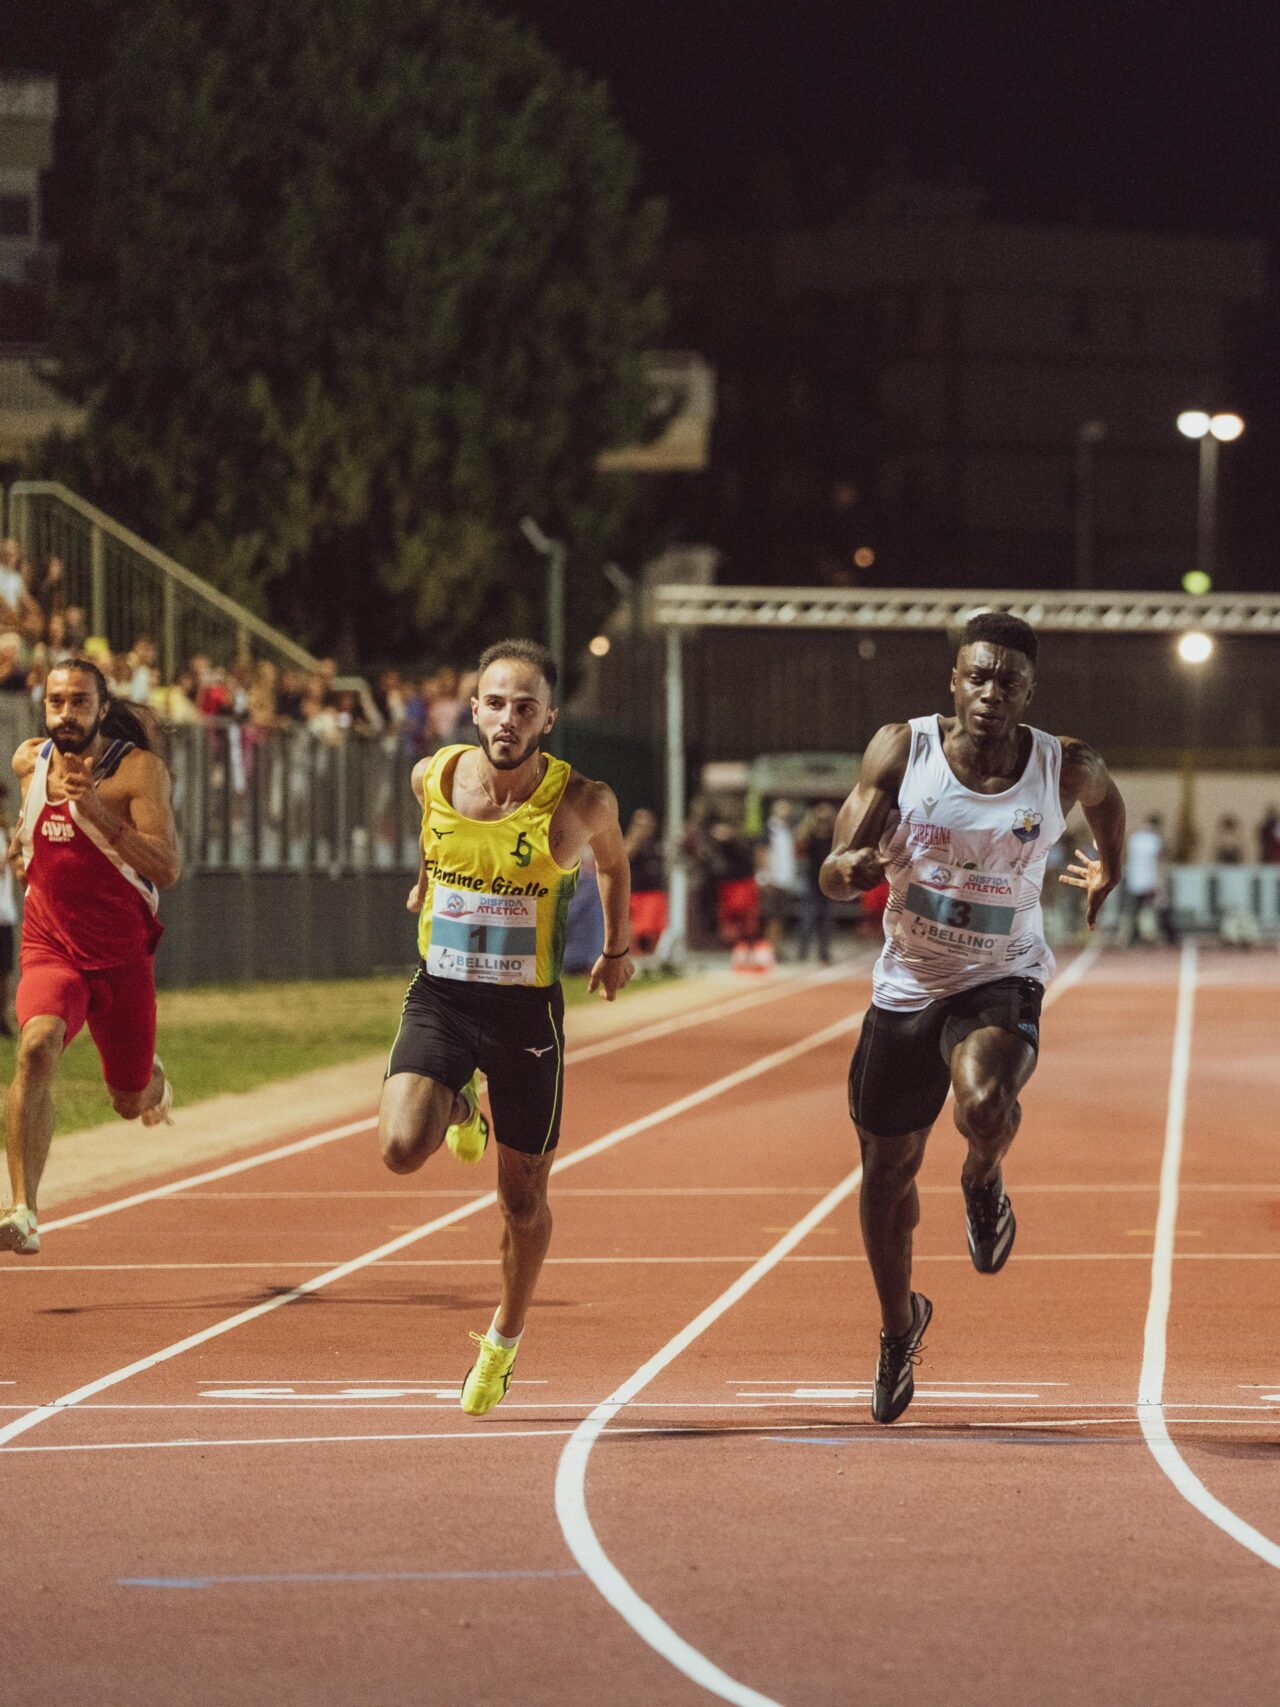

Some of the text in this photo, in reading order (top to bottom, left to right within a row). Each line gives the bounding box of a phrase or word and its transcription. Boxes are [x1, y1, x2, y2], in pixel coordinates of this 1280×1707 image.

[969, 874, 1009, 886] DISFIDA
[963, 882, 1012, 895] ATLETICA
[480, 897, 523, 907] DISFIDA
[476, 905, 529, 916] ATLETICA
[947, 901, 973, 928] 3
[469, 926, 488, 953] 1
[928, 925, 996, 949] BELLINO
[456, 955, 523, 971] BELLINO
